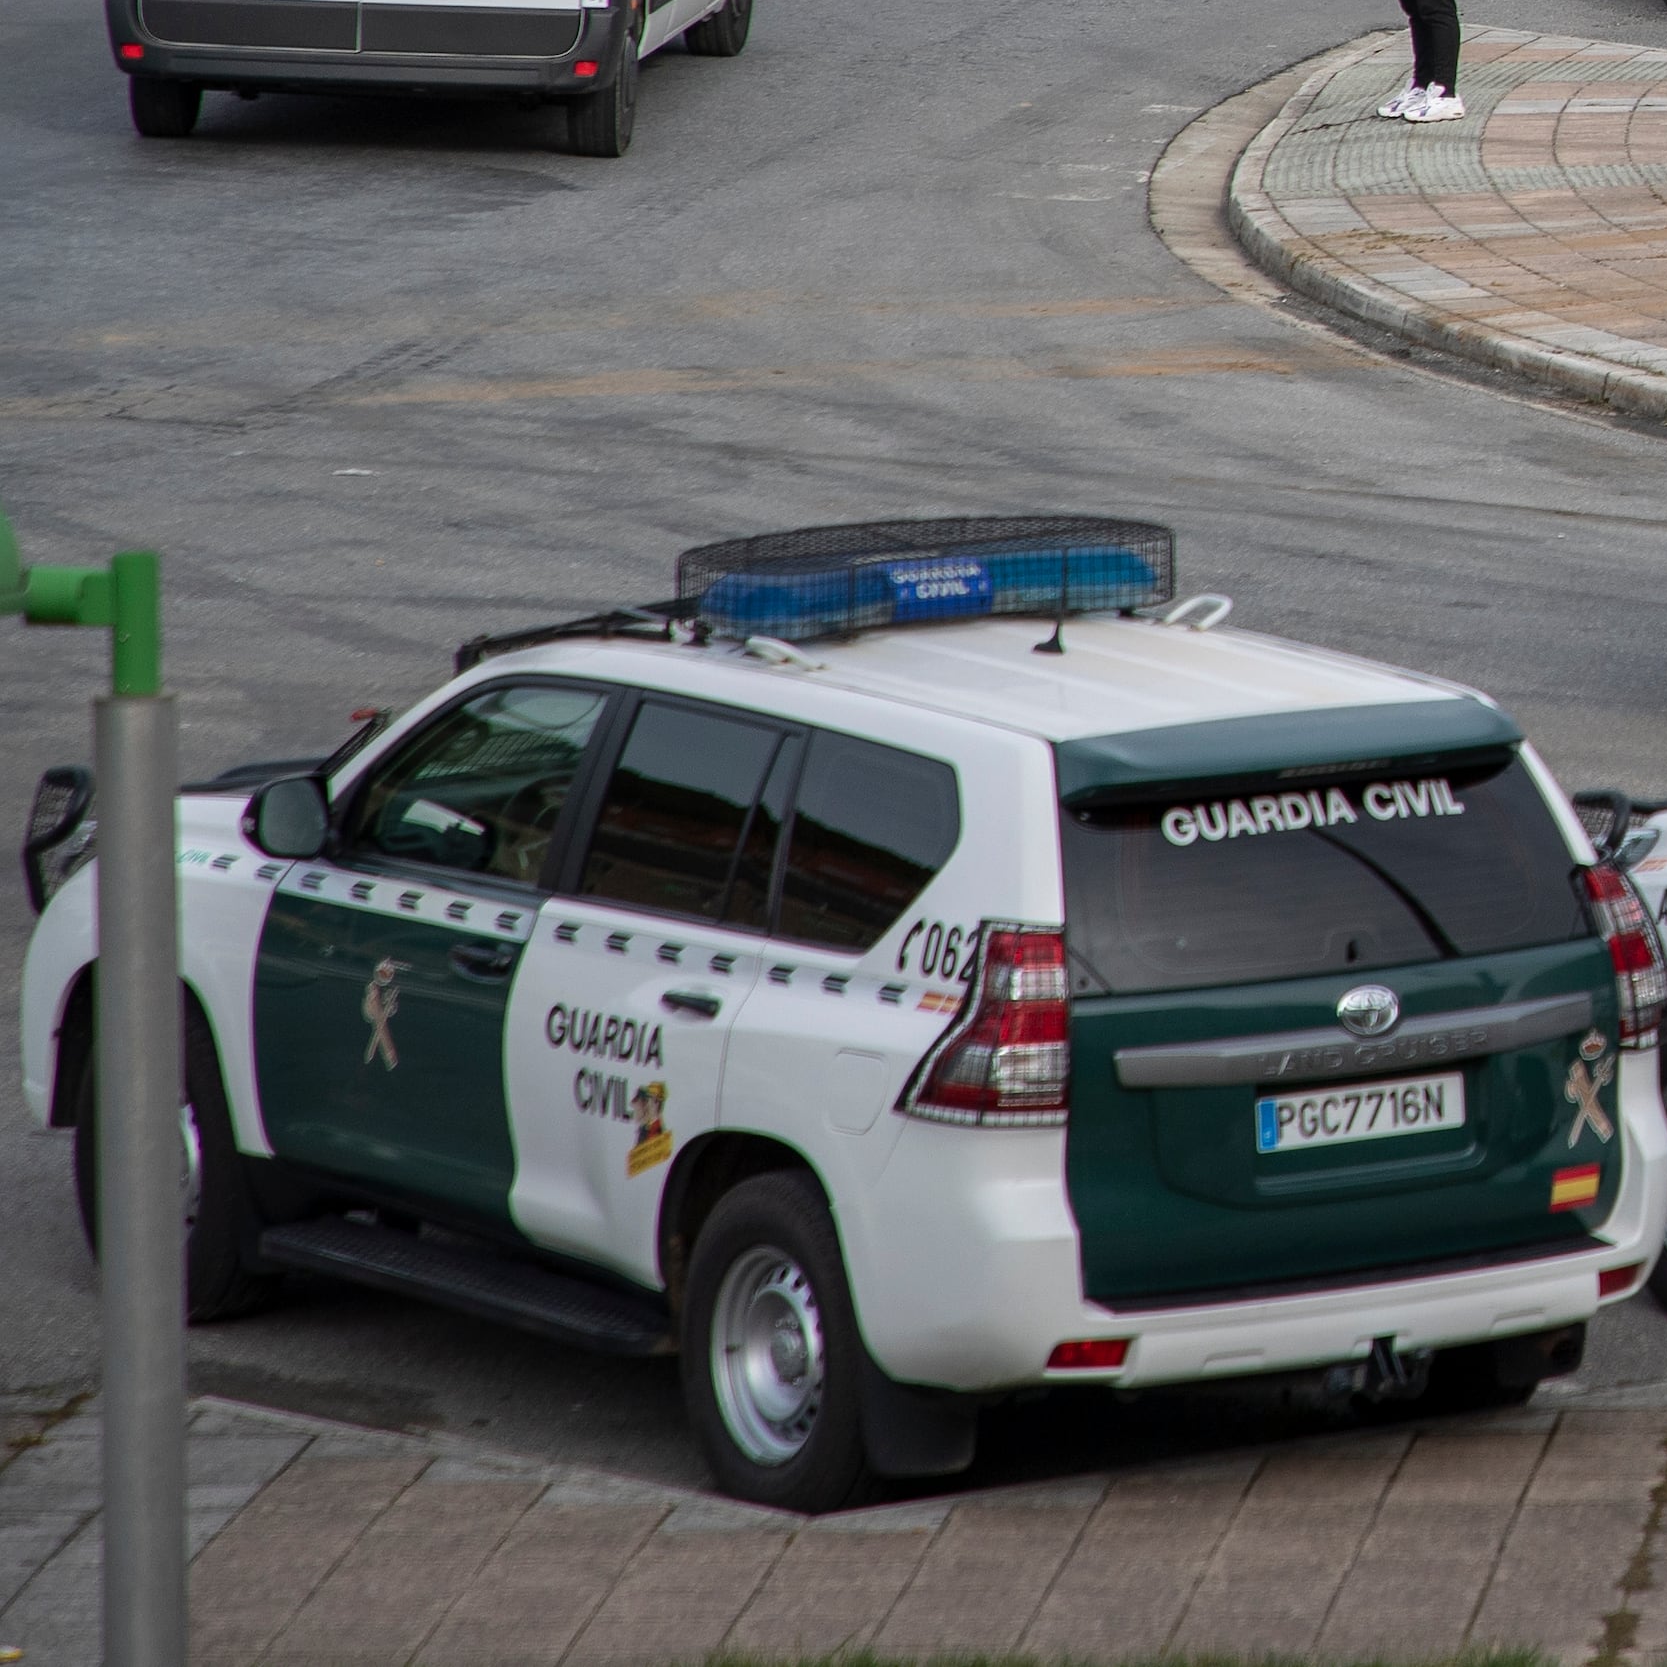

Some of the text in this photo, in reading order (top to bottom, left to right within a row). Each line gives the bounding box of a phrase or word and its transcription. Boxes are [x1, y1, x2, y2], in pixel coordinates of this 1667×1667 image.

[1162, 777, 1465, 847] GUARDIA CIVIL
[921, 921, 980, 983] 062
[547, 1002, 664, 1069] GUARDIA
[1353, 1031, 1489, 1069] CRUISER
[573, 1067, 634, 1122] CIVIL
